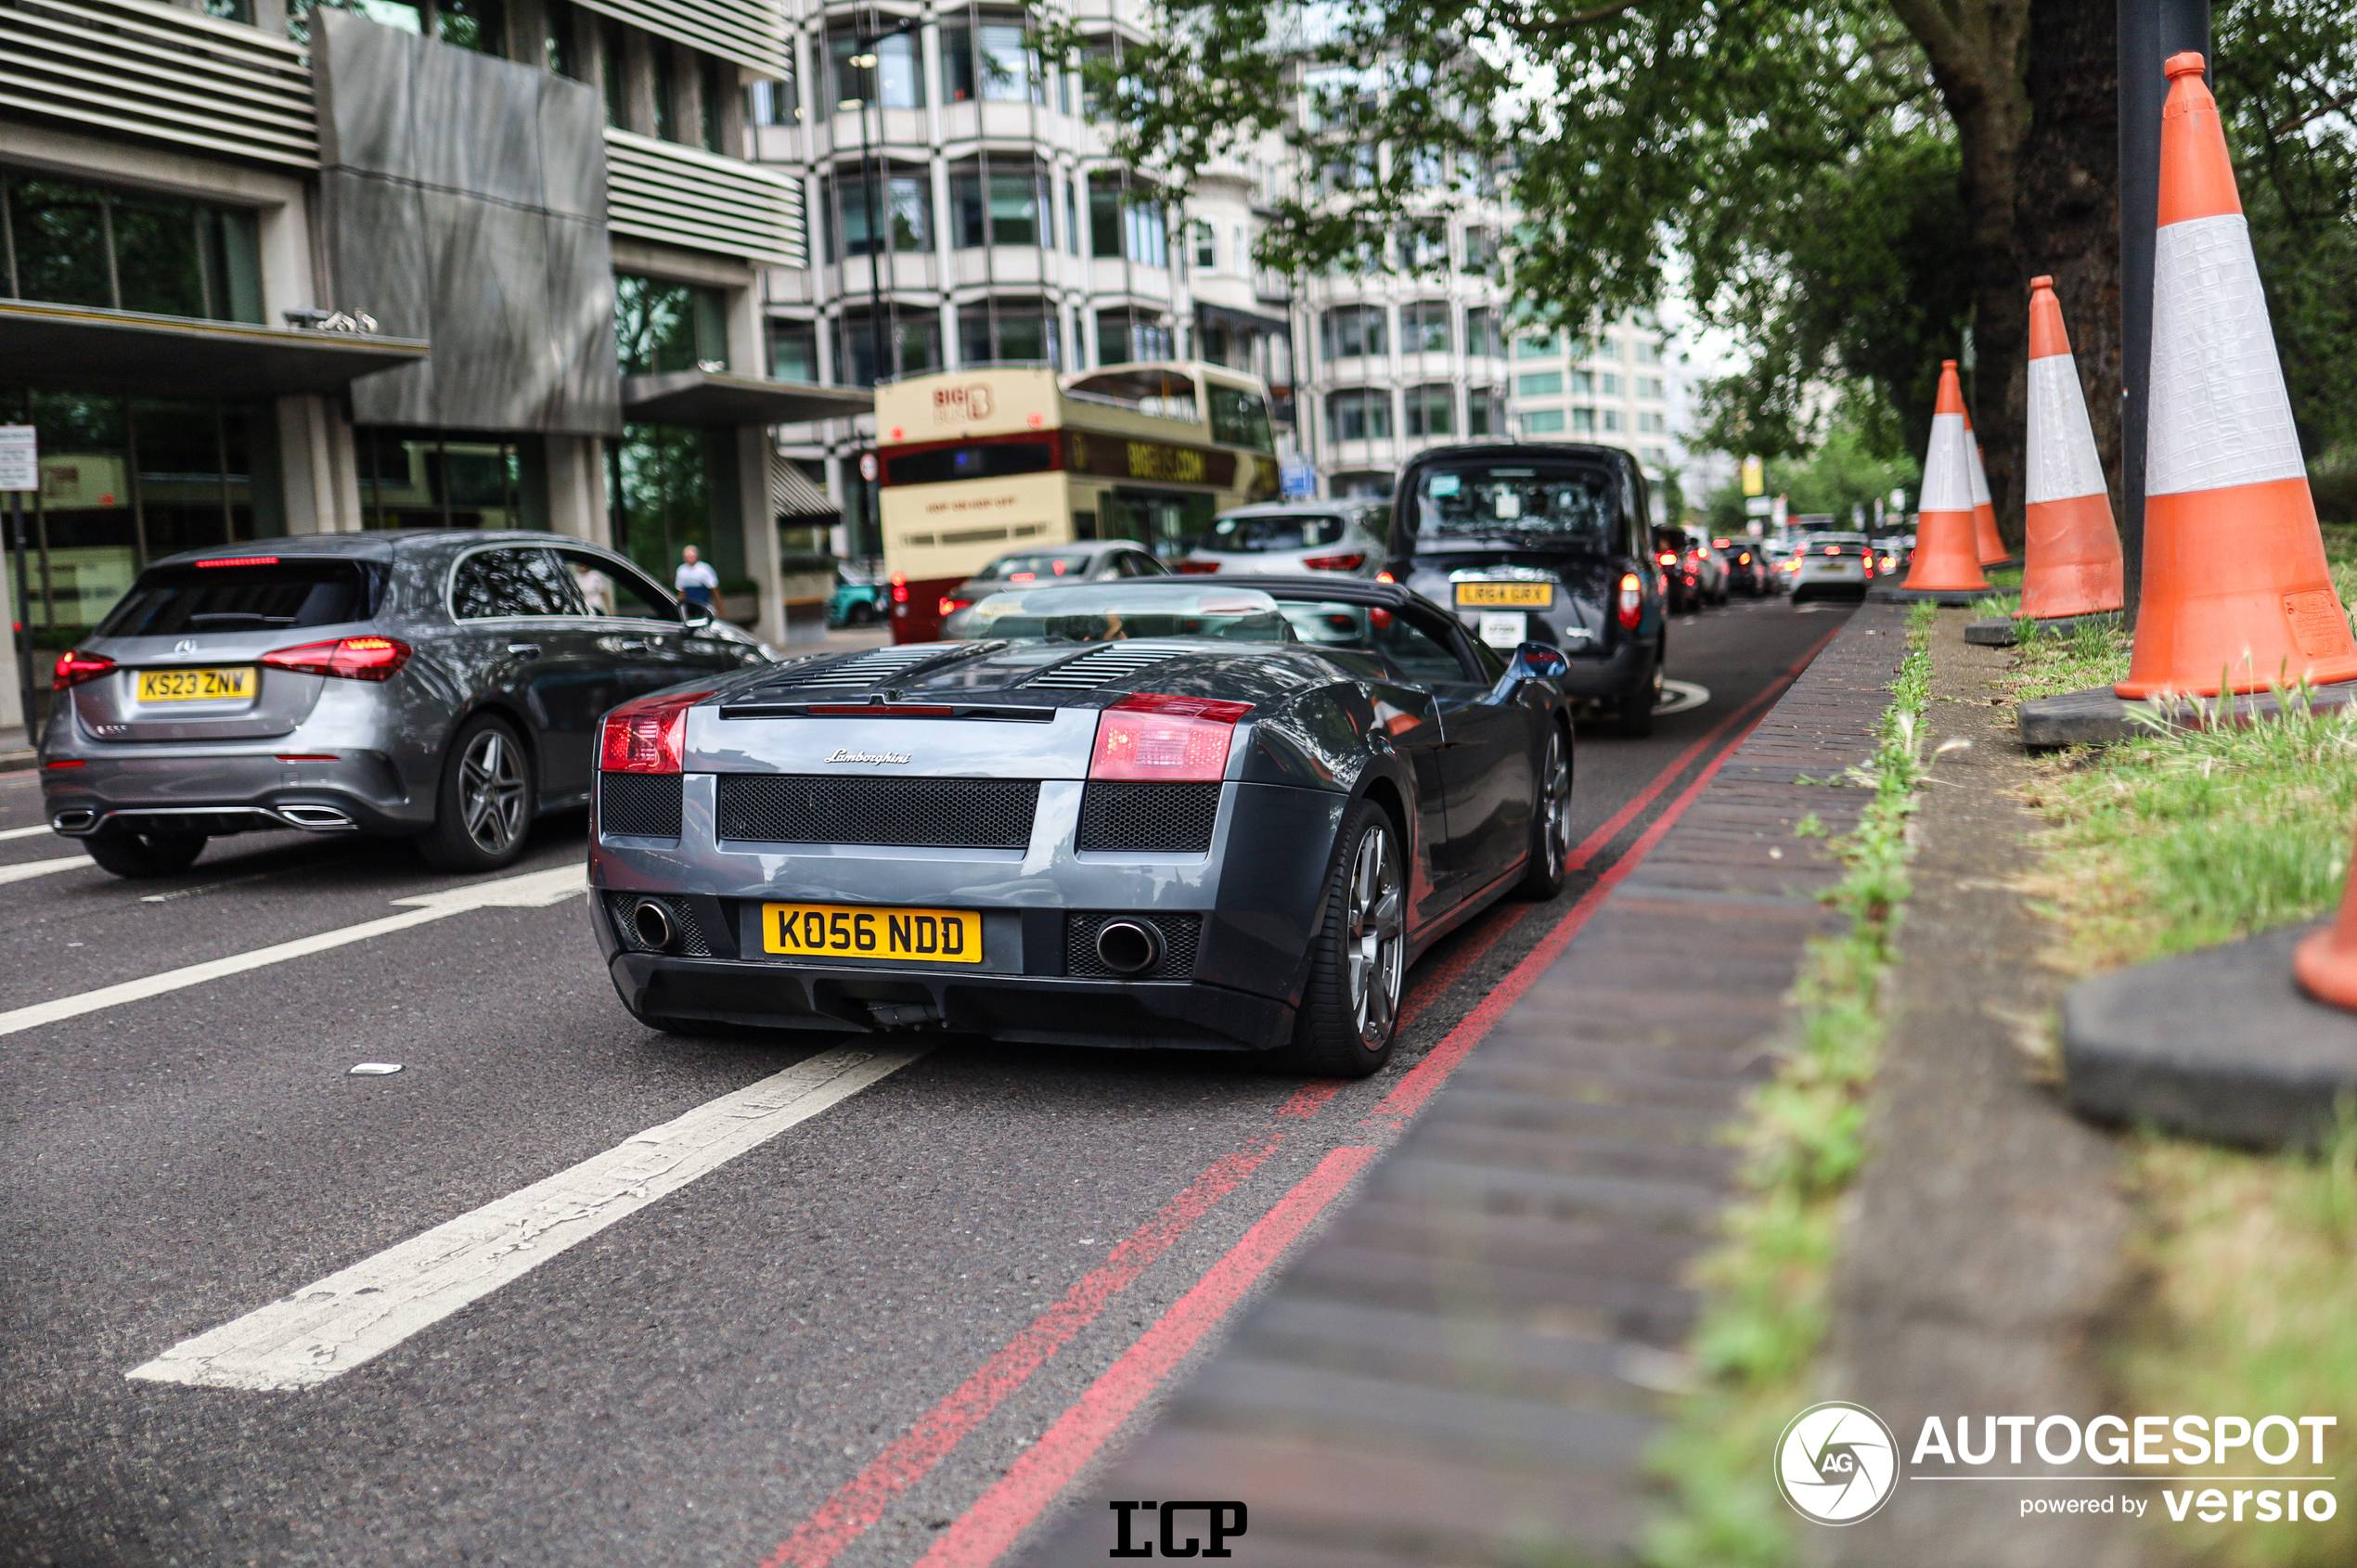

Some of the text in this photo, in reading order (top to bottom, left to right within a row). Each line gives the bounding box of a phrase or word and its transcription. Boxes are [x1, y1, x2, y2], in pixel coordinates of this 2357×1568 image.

[933, 387, 965, 406] BIG
[145, 671, 244, 696] KS23 ZNW
[824, 748, 911, 766] Lamborghini
[779, 911, 963, 955] KO56 NDD
